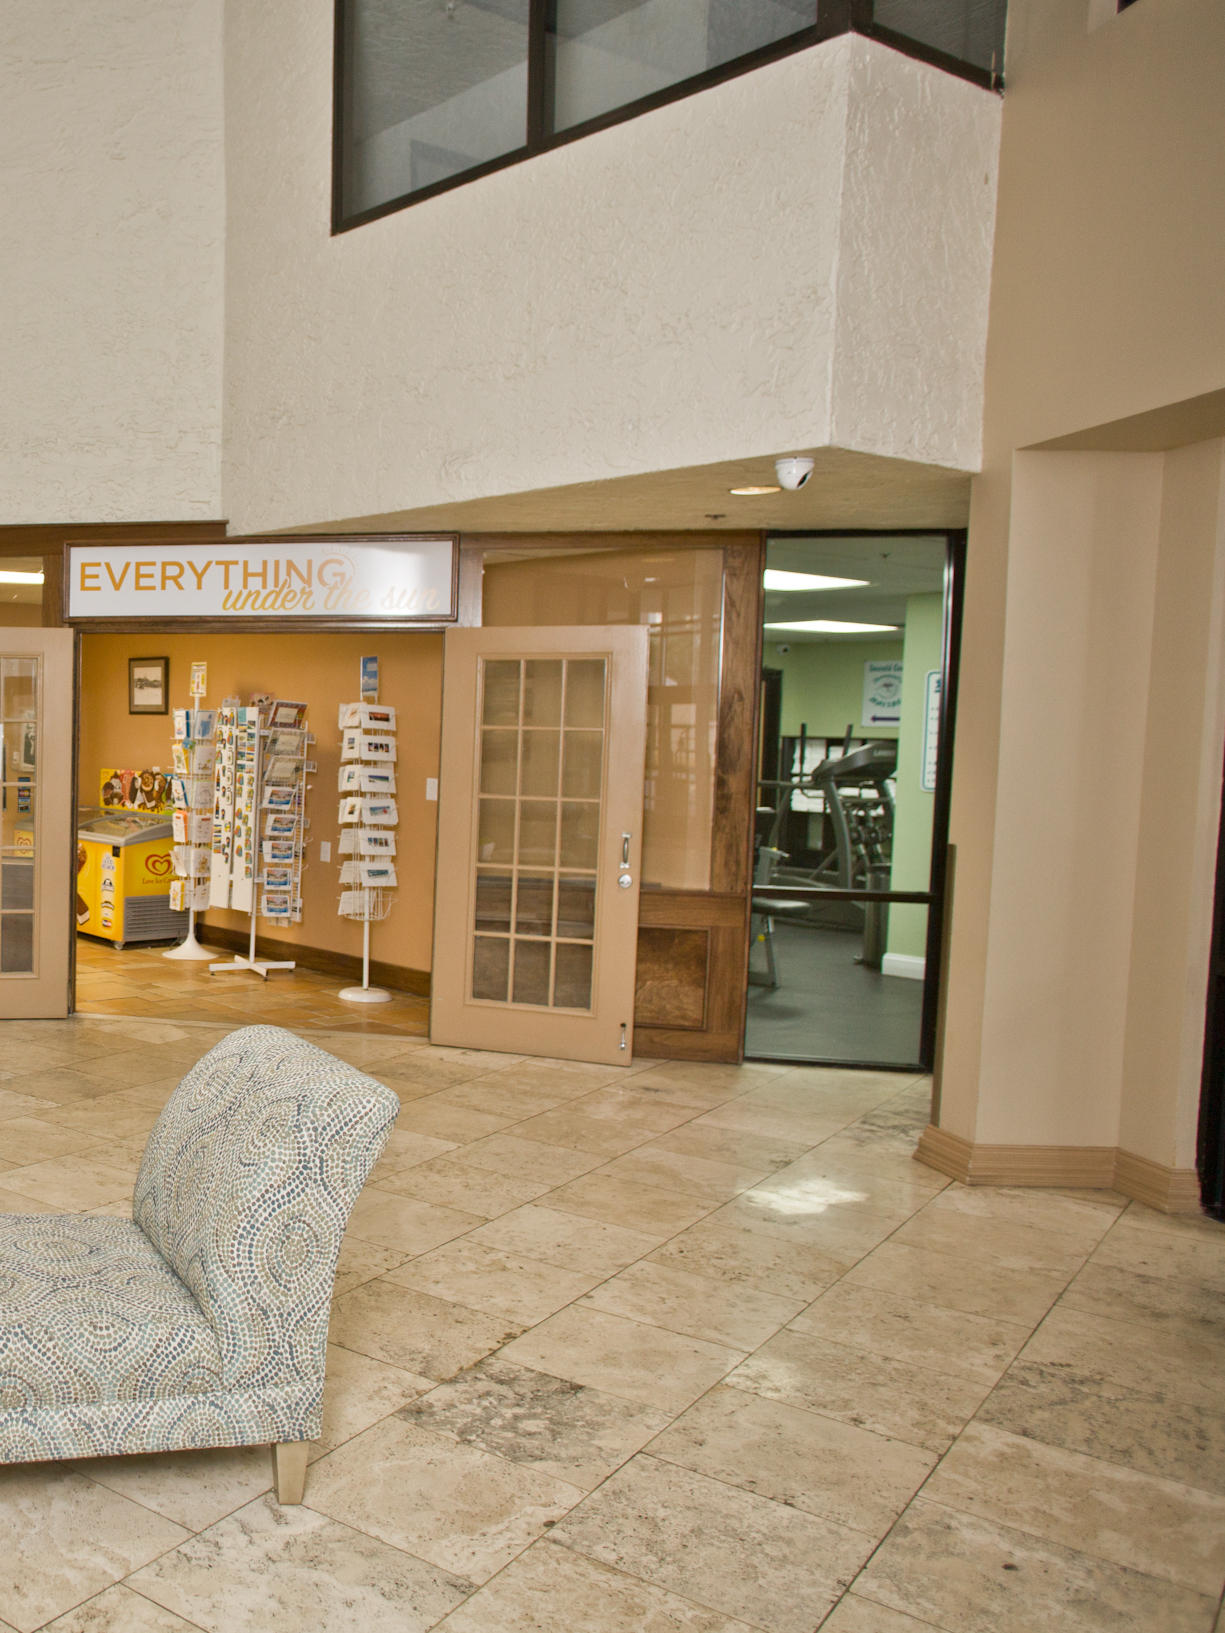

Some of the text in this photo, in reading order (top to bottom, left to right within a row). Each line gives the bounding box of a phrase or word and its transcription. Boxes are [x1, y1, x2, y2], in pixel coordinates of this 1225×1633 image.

[79, 558, 345, 592] EVERYTHING
[221, 575, 440, 612] under the sun
